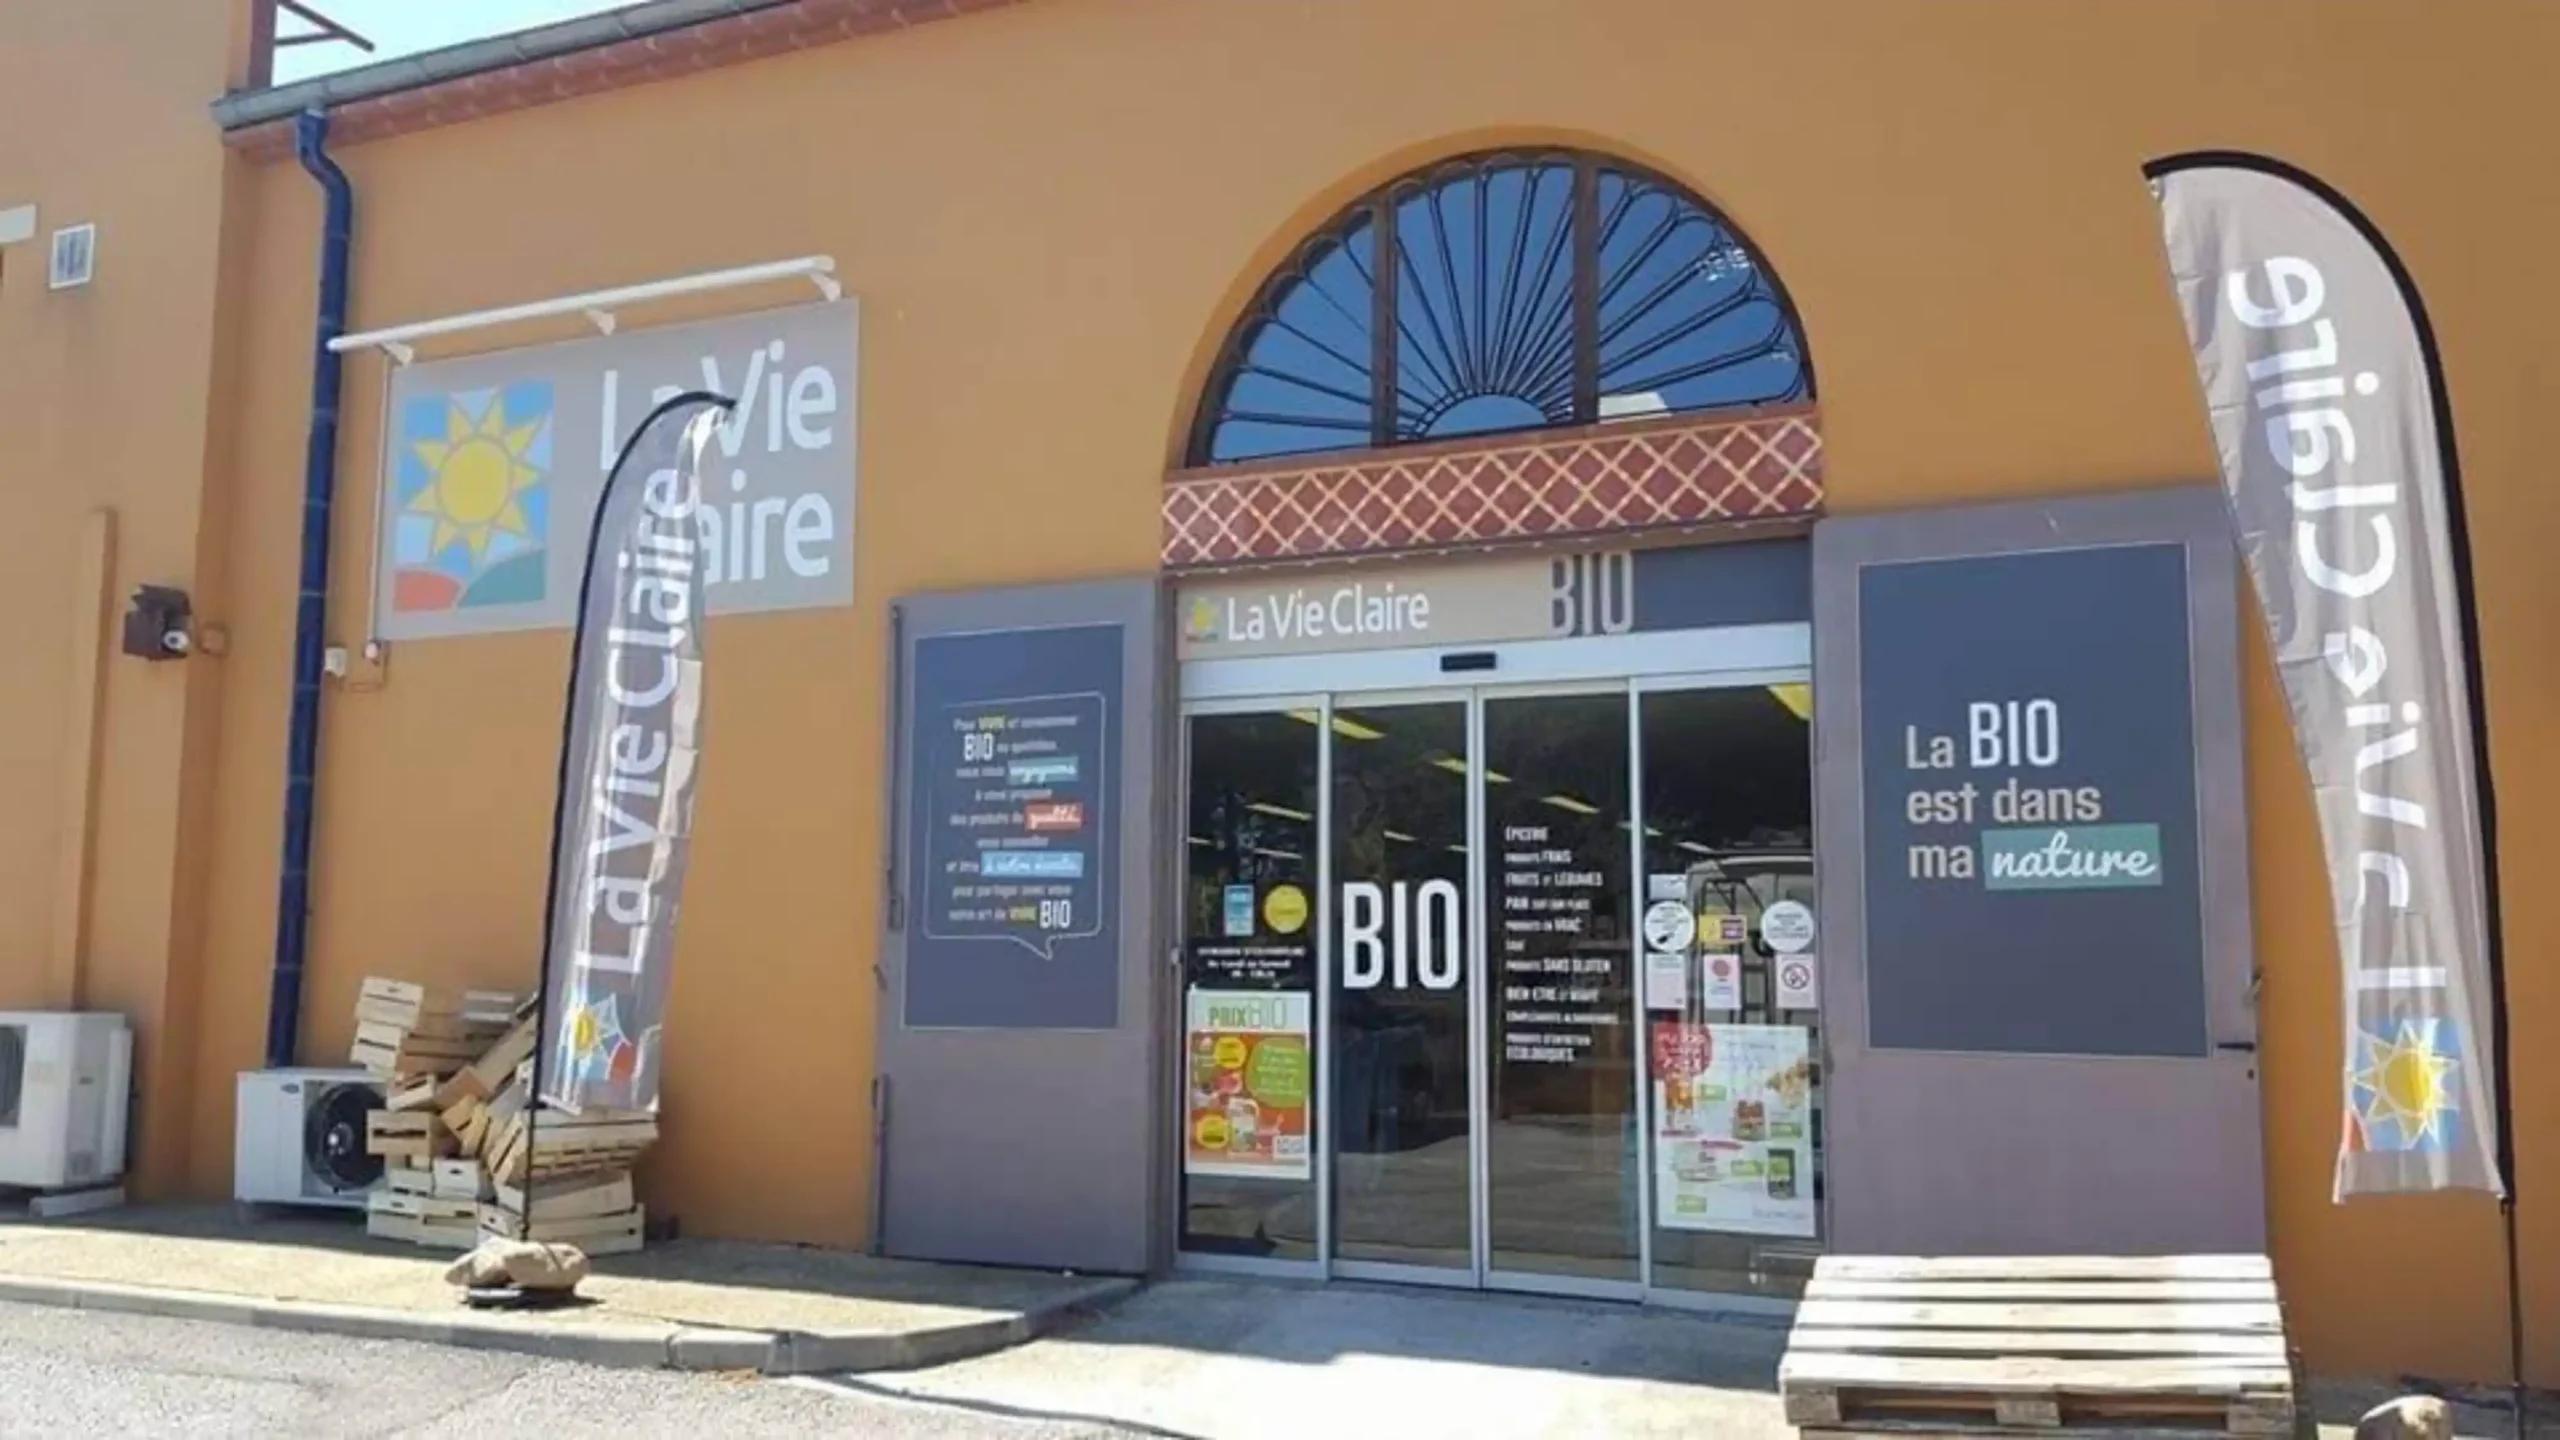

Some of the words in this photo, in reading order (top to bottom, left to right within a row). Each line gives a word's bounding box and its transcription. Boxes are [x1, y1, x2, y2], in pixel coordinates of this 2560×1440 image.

[701, 340, 837, 458] Vie
[697, 468, 834, 583] aire
[607, 468, 700, 708] Claire
[1227, 596, 1265, 642] La
[1269, 590, 1324, 638] Vie
[1329, 583, 1431, 635] Claire
[1547, 552, 1633, 636] BIO
[964, 732, 995, 763] BIO
[1906, 725, 1955, 769] La
[1969, 698, 2060, 768] BIO
[591, 723, 668, 858] Vie
[1906, 782, 1979, 823] est
[1991, 777, 2103, 822] dans
[1908, 845, 1976, 879] ma
[1991, 830, 2158, 878] nature
[1039, 898, 1073, 931] BIO
[1343, 878, 1461, 990] BIO
